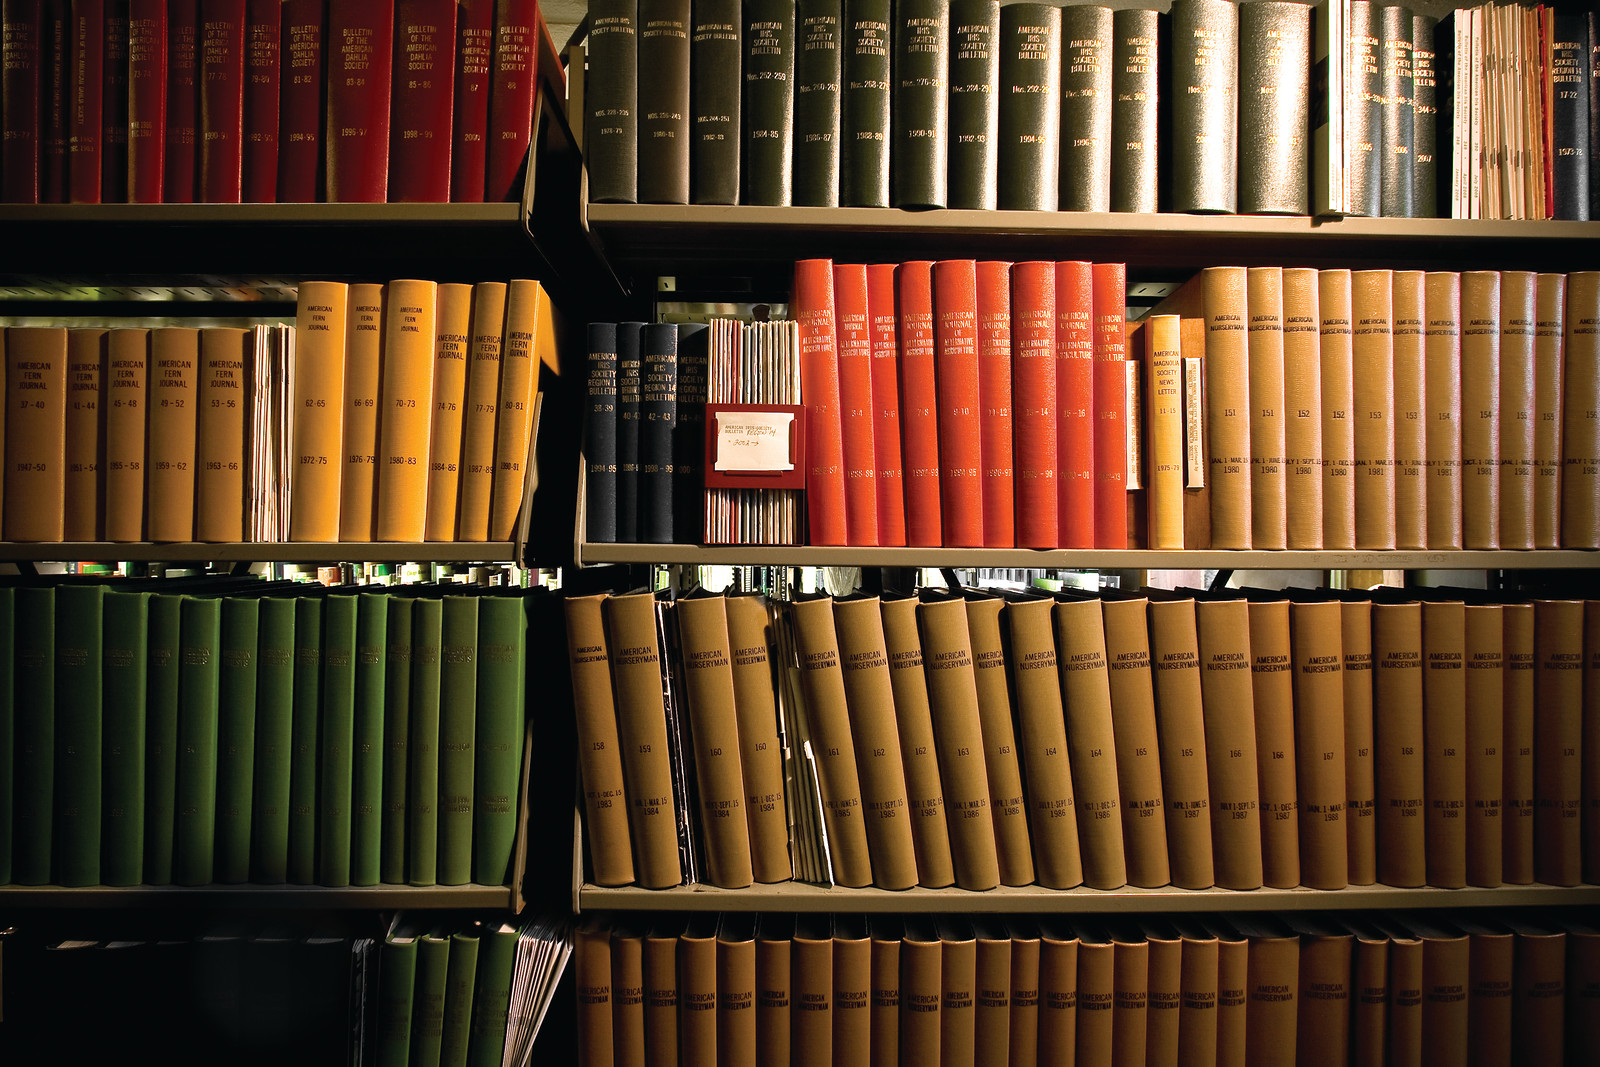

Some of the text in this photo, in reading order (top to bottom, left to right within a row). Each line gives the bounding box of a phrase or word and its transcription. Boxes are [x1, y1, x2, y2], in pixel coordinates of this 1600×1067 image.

[291, 25, 318, 34] BULLETIN
[408, 25, 436, 33] BULLETIN
[751, 22, 782, 31] AMERICAN
[958, 25, 989, 34] AMERICAN
[1018, 26, 1049, 34] AMERICAN
[807, 33, 832, 41] SOCIETY
[290, 42, 319, 50] AMERICAN
[753, 38, 779, 47] SOCIETY
[805, 41, 834, 50] BULLETIN
[961, 42, 986, 50] SOCIETY
[1553, 41, 1581, 51] AMERICAN
[407, 44, 437, 52] AMERICAN
[752, 47, 781, 55] BULLETIN
[1021, 43, 1046, 51] SOCIETY
[293, 51, 314, 59] DAHLIA
[410, 53, 432, 61] DAHLIA
[292, 59, 315, 67] SOCIETY
[409, 62, 433, 70] SOCIETY
[1555, 58, 1579, 67] SOCIETY
[1553, 74, 1581, 83] BULLETIN
[752, 130, 779, 139] 1984-85
[437, 334, 467, 343] AMERICAN
[509, 332, 532, 340] AMERICAN
[443, 343, 458, 351] FERN
[511, 340, 528, 348] FERN
[438, 351, 464, 360] JOURNAL
[509, 349, 528, 357] JOURNAL
[645, 355, 675, 363] AMERICAN
[18, 362, 51, 370] AMERICAN
[112, 361, 143, 369] AMERICAN
[158, 360, 191, 368] AMERICAN
[209, 361, 242, 369] AMERICAN
[24, 372, 41, 380] FERN
[118, 370, 134, 378] FERN
[165, 370, 181, 378] FERN
[216, 370, 233, 378] FERN
[648, 374, 672, 382] SOCIETY
[19, 381, 47, 390] JOURNAL
[113, 380, 140, 388] JOURNAL
[159, 380, 187, 388] JOURNAL
[210, 380, 238, 388] JOURNAL
[645, 384, 667, 392] REGION
[645, 393, 675, 402] BULLETIN
[306, 400, 325, 408] 62-65
[396, 400, 415, 408] 70-73
[438, 403, 456, 411] 74-76
[505, 402, 523, 410] 80-81
[1225, 409, 1236, 417] 151
[1262, 409, 1274, 417] 151
[1333, 411, 1344, 419] 152
[300, 456, 327, 465] 1972-75
[389, 456, 416, 465] 1980-83
[431, 463, 456, 472] 1984-86
[620, 647, 652, 656] AMERICAN
[735, 647, 766, 656] AMERICAN
[1117, 652, 1147, 661] AMERICAN
[1213, 653, 1244, 662] AMERICAN
[1387, 652, 1418, 661] AMERICAN
[1112, 660, 1151, 670] NURSERYMAN
[1208, 661, 1249, 671] NURSERYMAN
[593, 742, 605, 750] 158
[639, 745, 651, 753] 159
[755, 743, 766, 751] 160
[710, 748, 721, 756] 160
[873, 749, 885, 757] 162
[958, 748, 969, 756] 163
[1045, 748, 1056, 756] 164
[1136, 748, 1147, 756] 165
[1230, 750, 1241, 758] 166
[1324, 752, 1334, 760] 167
[597, 800, 612, 808] 1983
[760, 804, 775, 812] 1984
[644, 807, 659, 815] 1984
[1140, 809, 1154, 817] 1987
[1232, 811, 1248, 819] 1987
[1257, 985, 1289, 993] AMERICAN
[908, 994, 938, 1004] AMERICAN
[1081, 992, 1112, 1002] AMERICAN
